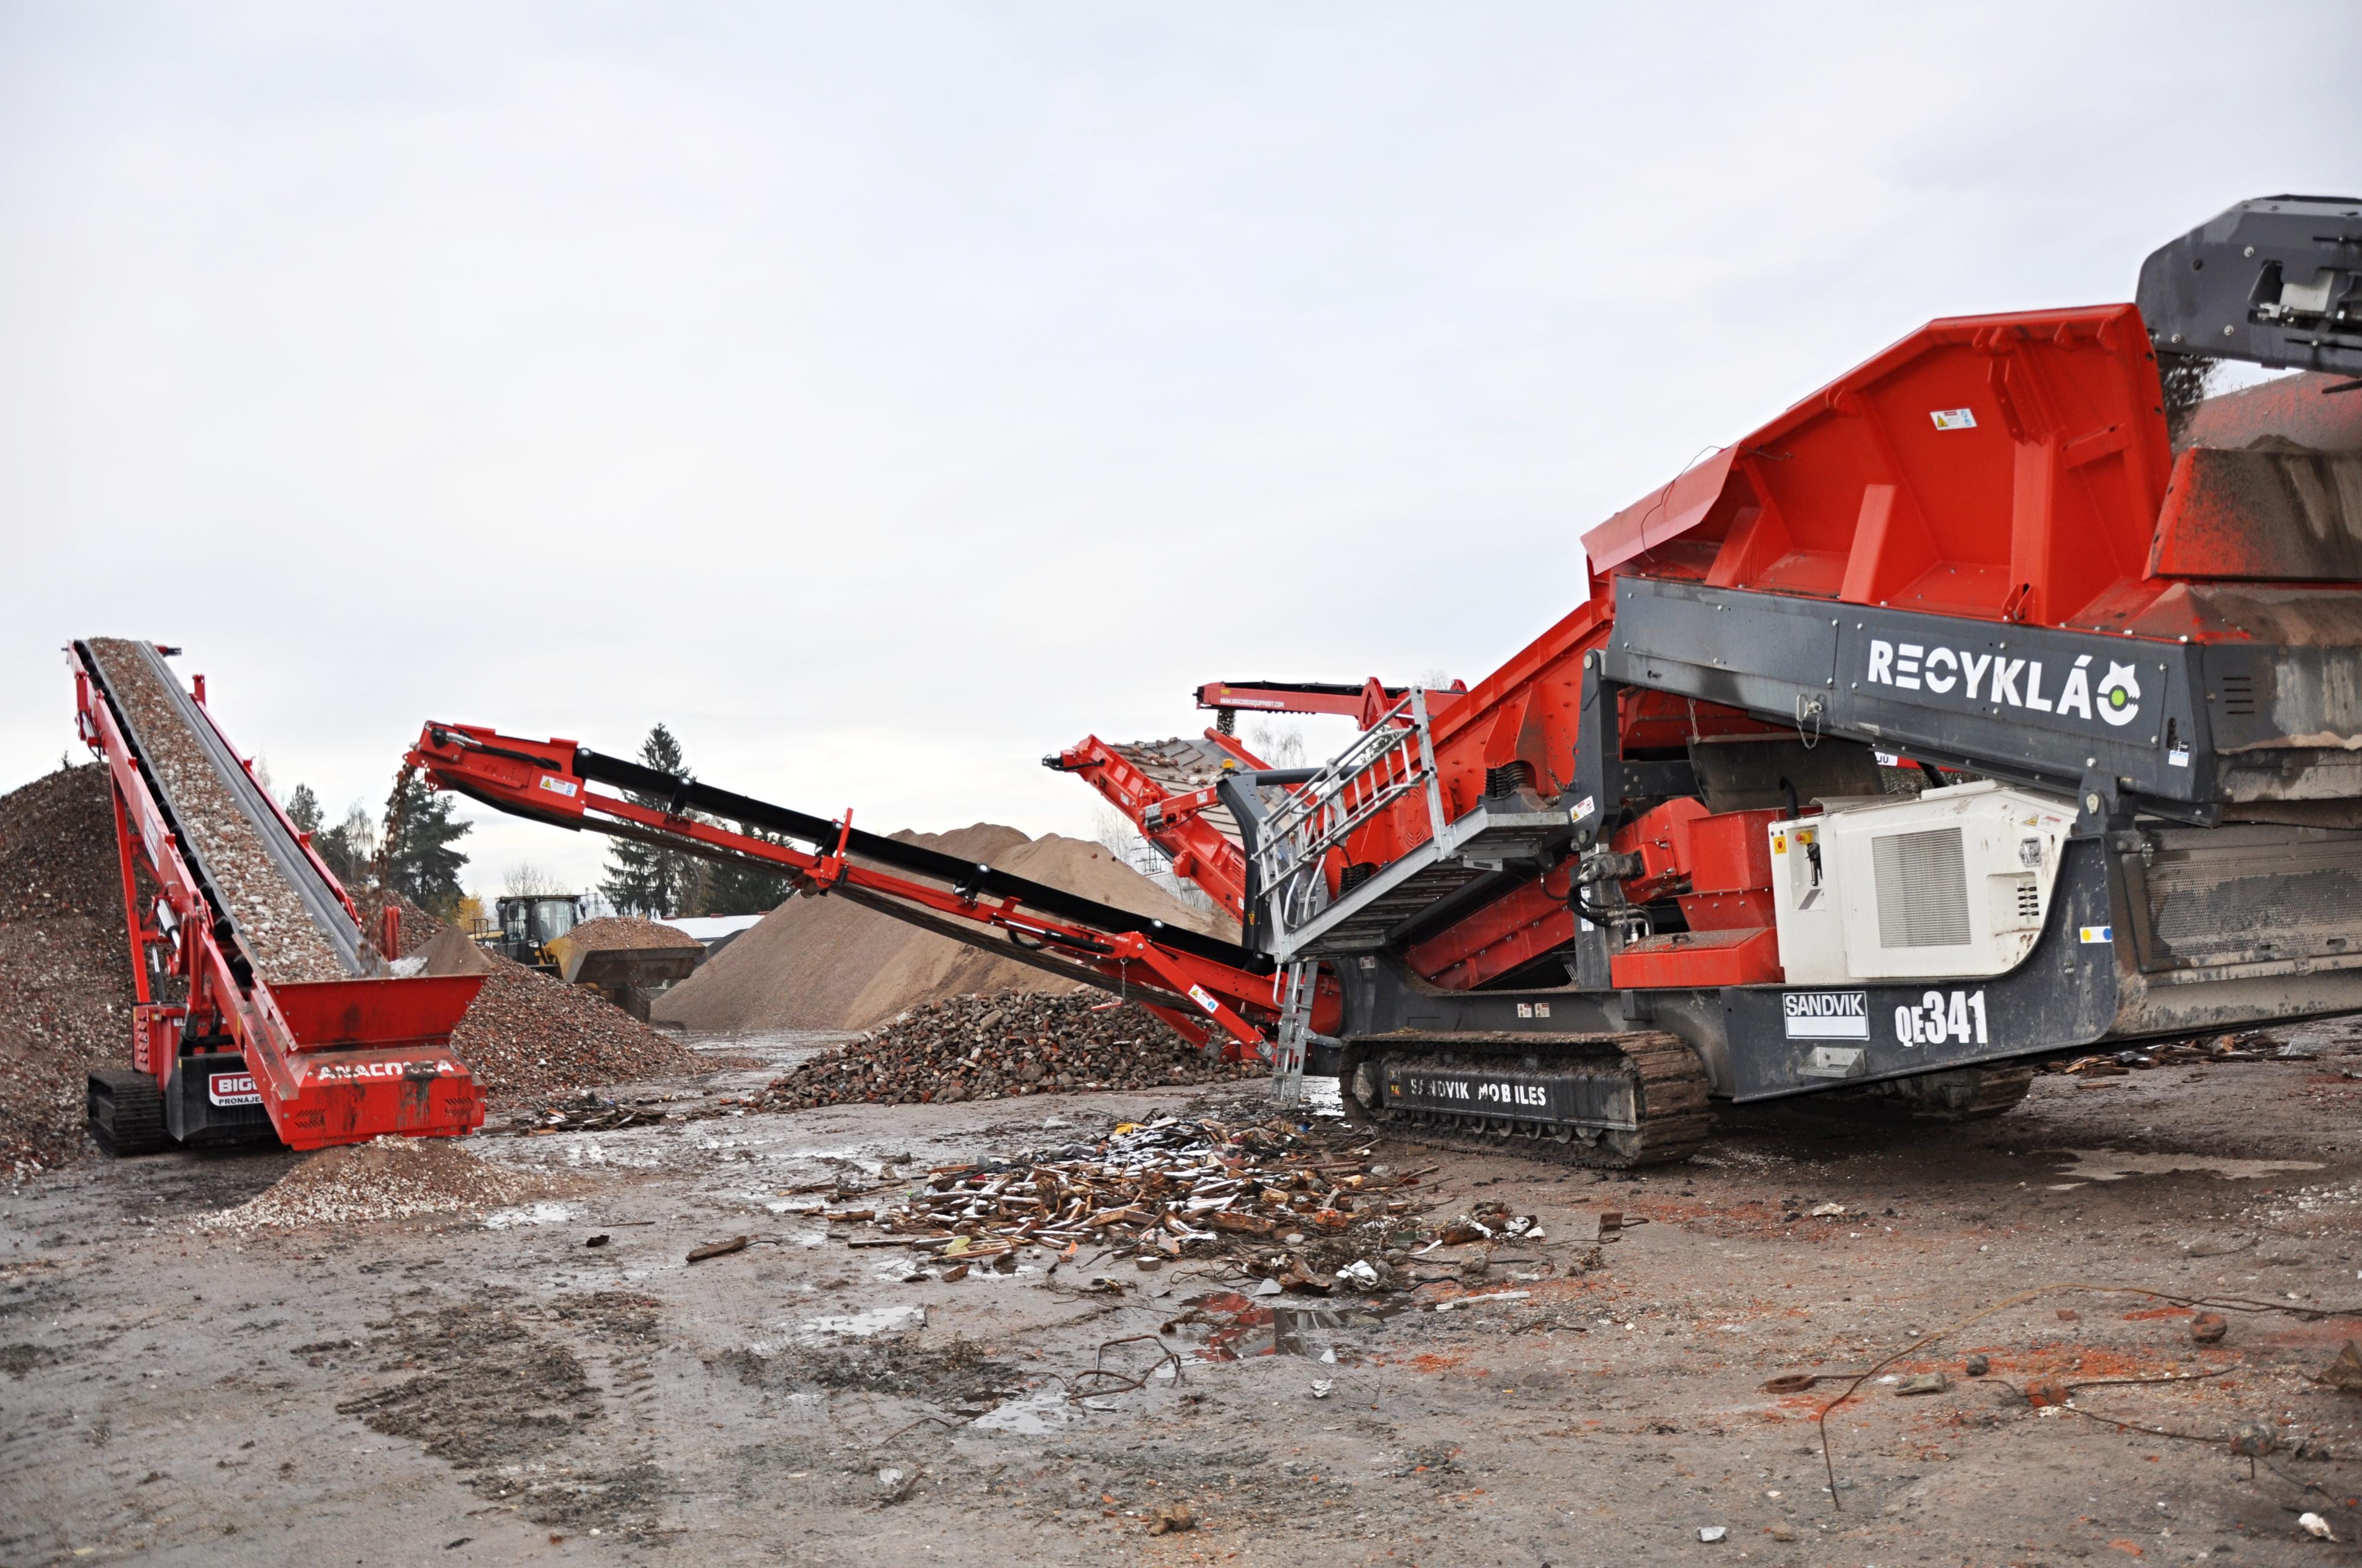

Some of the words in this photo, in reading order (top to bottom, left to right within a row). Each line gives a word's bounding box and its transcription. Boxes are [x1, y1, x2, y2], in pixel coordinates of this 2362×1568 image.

[1785, 994, 1865, 1017] SANDVIK
[1895, 991, 1988, 1047] QE341
[318, 1059, 454, 1080] ANACOA
[219, 1077, 258, 1093] BIG
[1478, 1083, 1547, 1106] MOBILES
[219, 1096, 263, 1105] PRONÁJE
